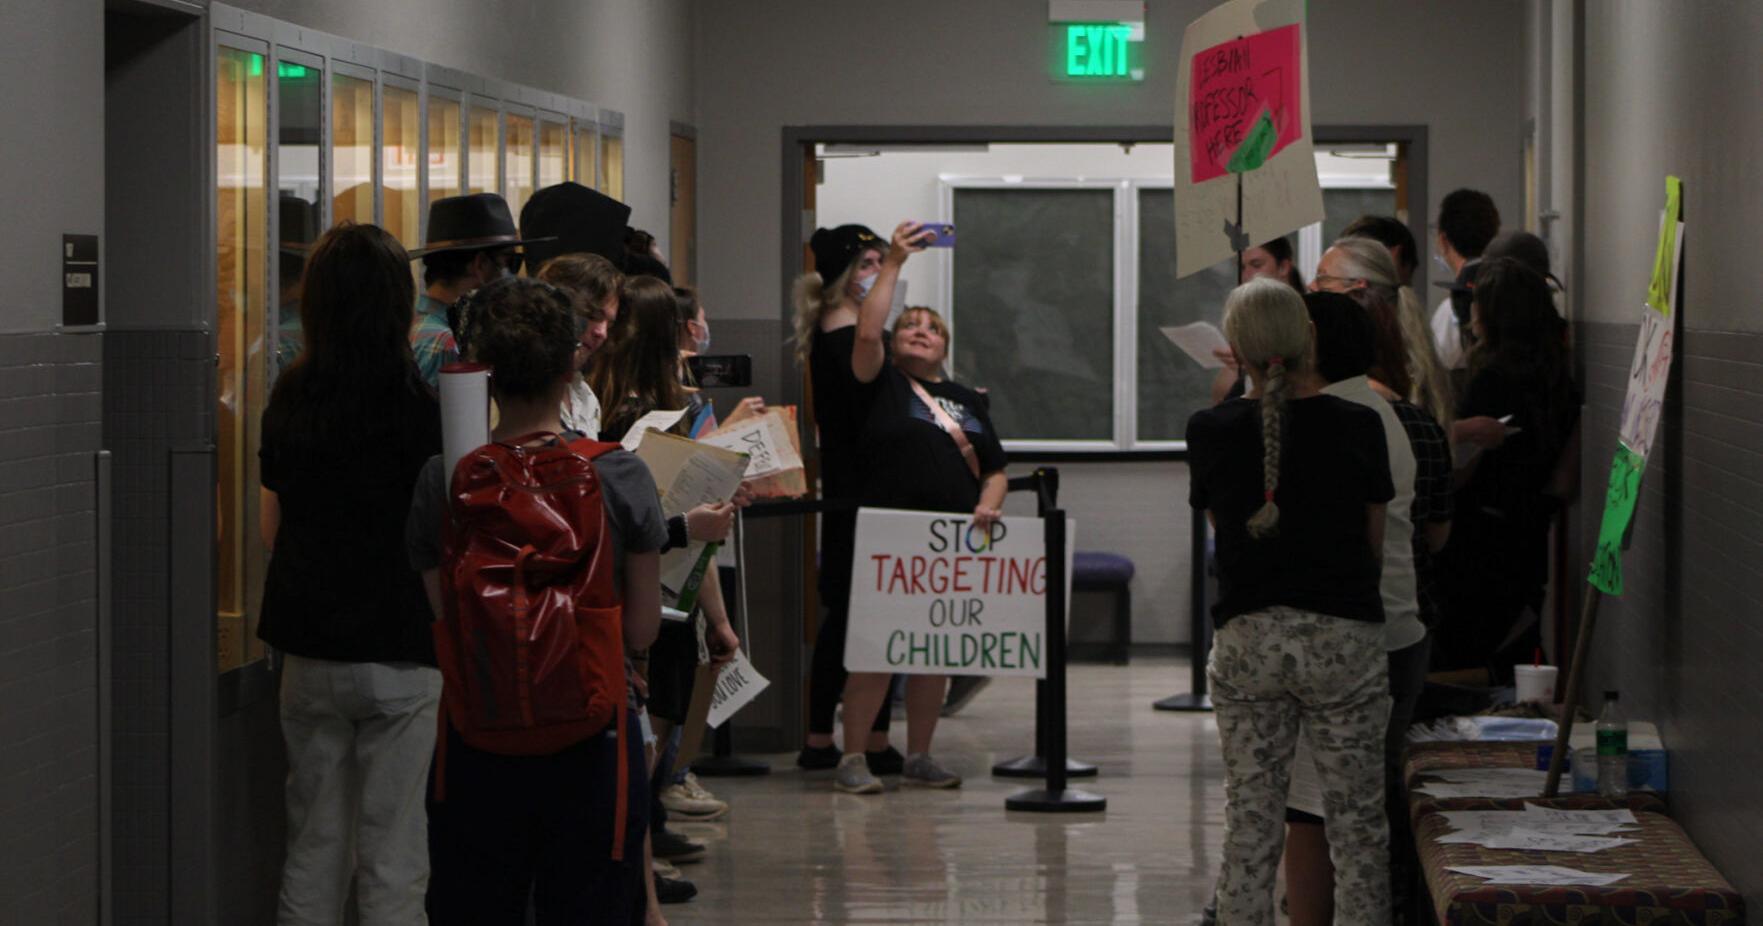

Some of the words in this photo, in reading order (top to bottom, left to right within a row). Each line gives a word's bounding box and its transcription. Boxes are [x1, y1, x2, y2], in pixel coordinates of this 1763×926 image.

[1067, 24, 1133, 76] EXIT
[1207, 119, 1243, 166] HERE
[928, 518, 1007, 553] STOP
[871, 554, 1048, 595] TARGETING
[929, 598, 984, 628] OUR
[886, 629, 1040, 669] CHILDREN
[721, 666, 750, 696] LOVE
